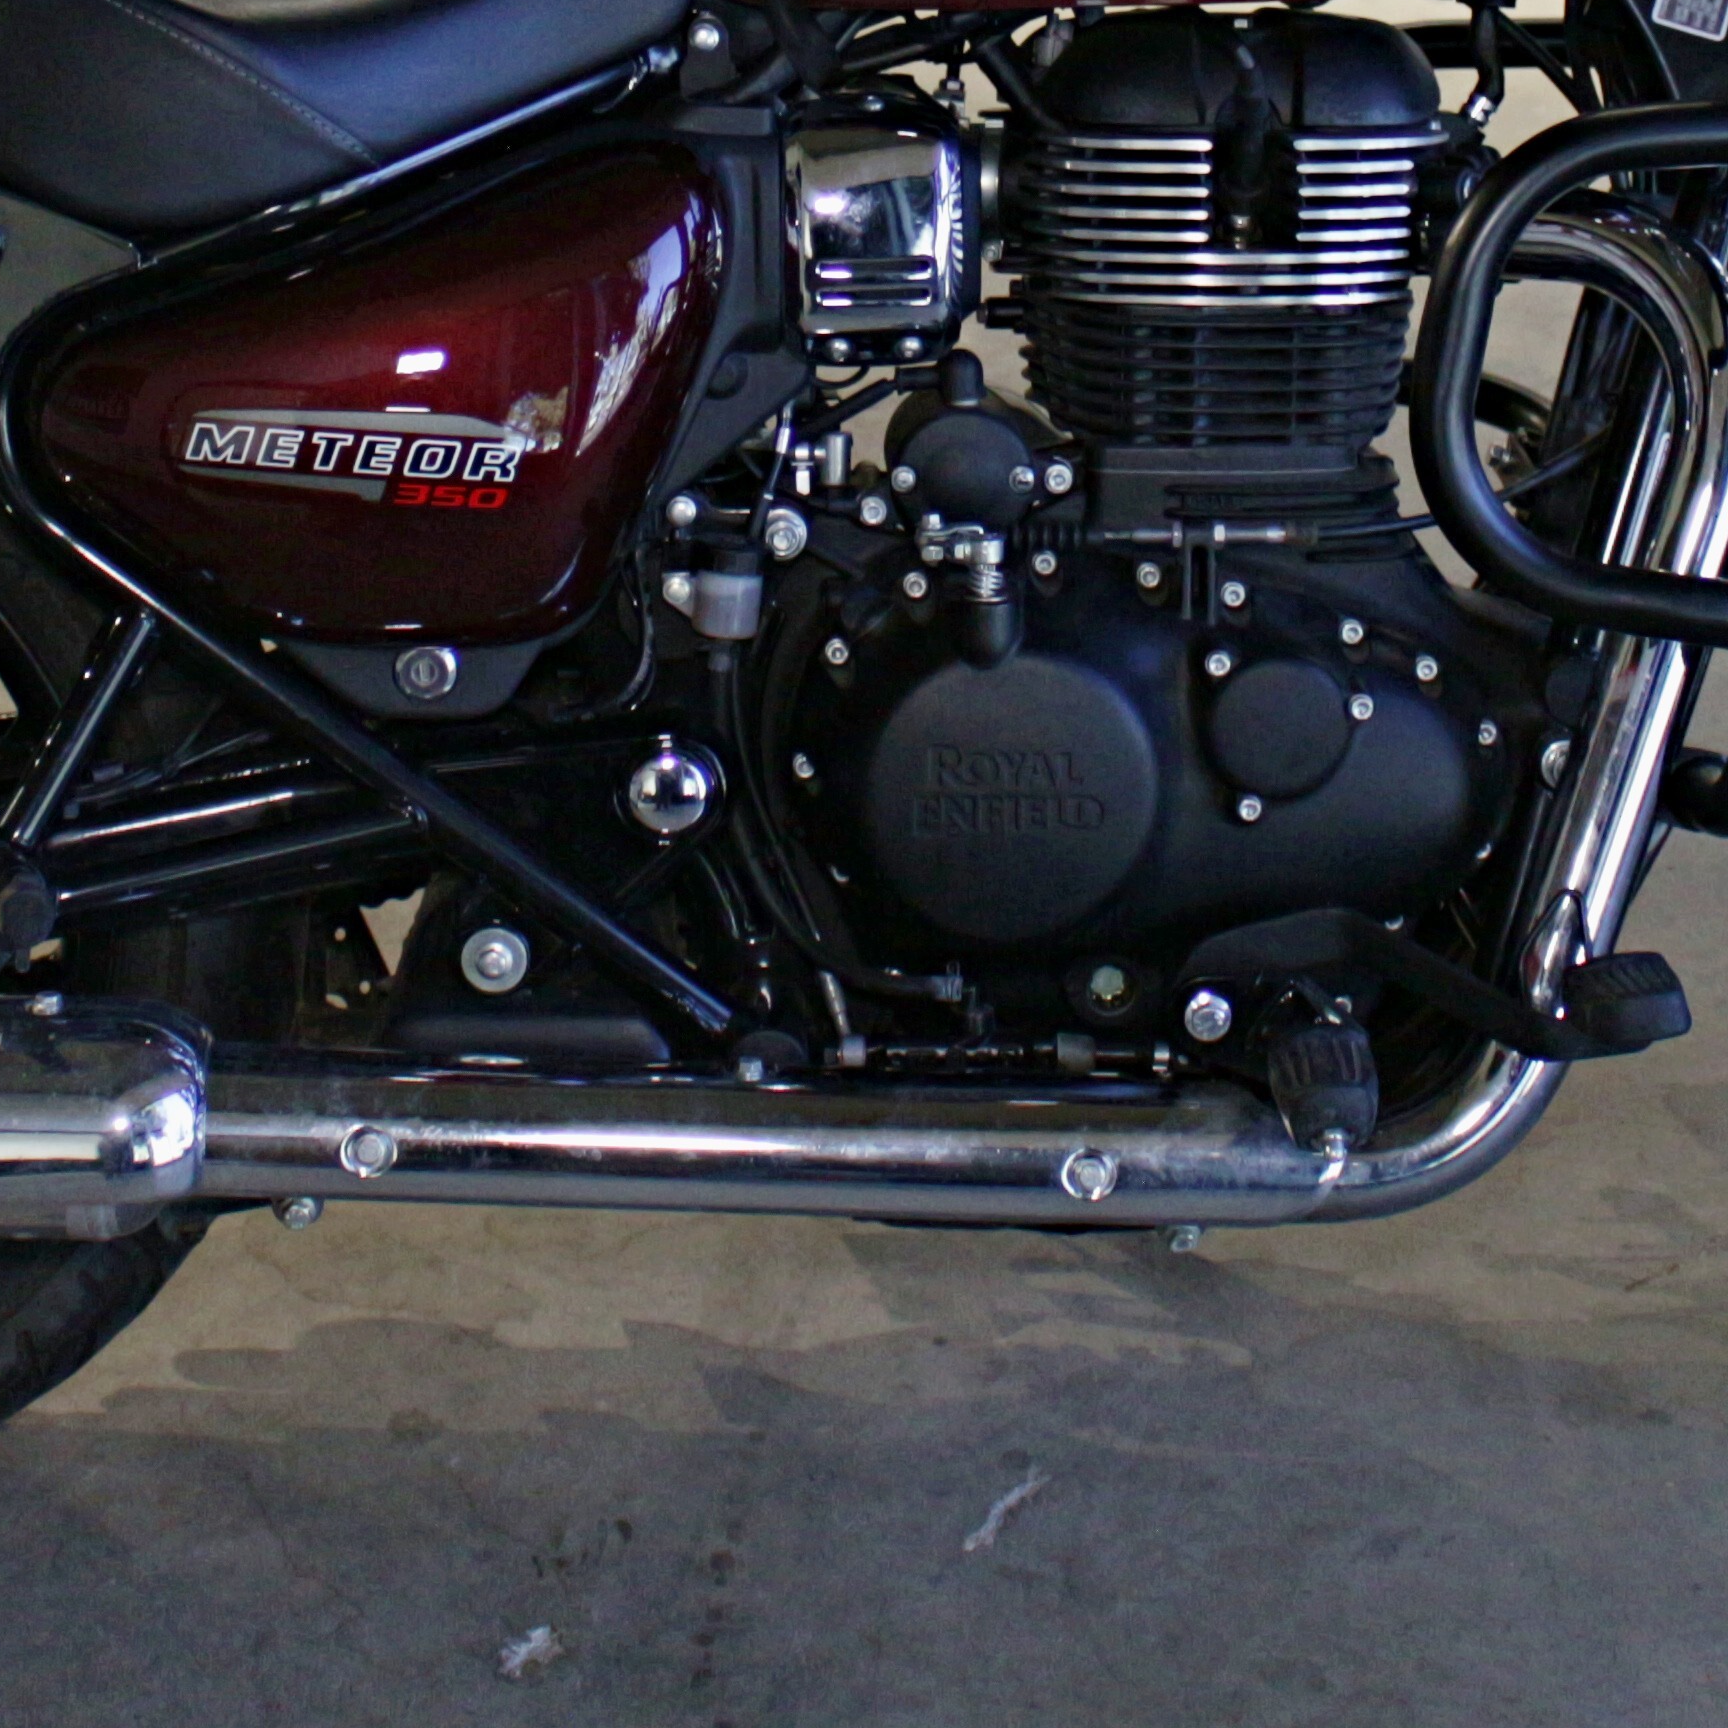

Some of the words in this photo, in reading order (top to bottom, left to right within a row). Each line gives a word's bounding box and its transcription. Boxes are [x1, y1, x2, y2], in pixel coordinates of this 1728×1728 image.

[184, 422, 524, 483] METEOR
[393, 483, 510, 510] 350
[926, 742, 1084, 788] ROYAL
[912, 791, 1105, 837] ENFIELD
